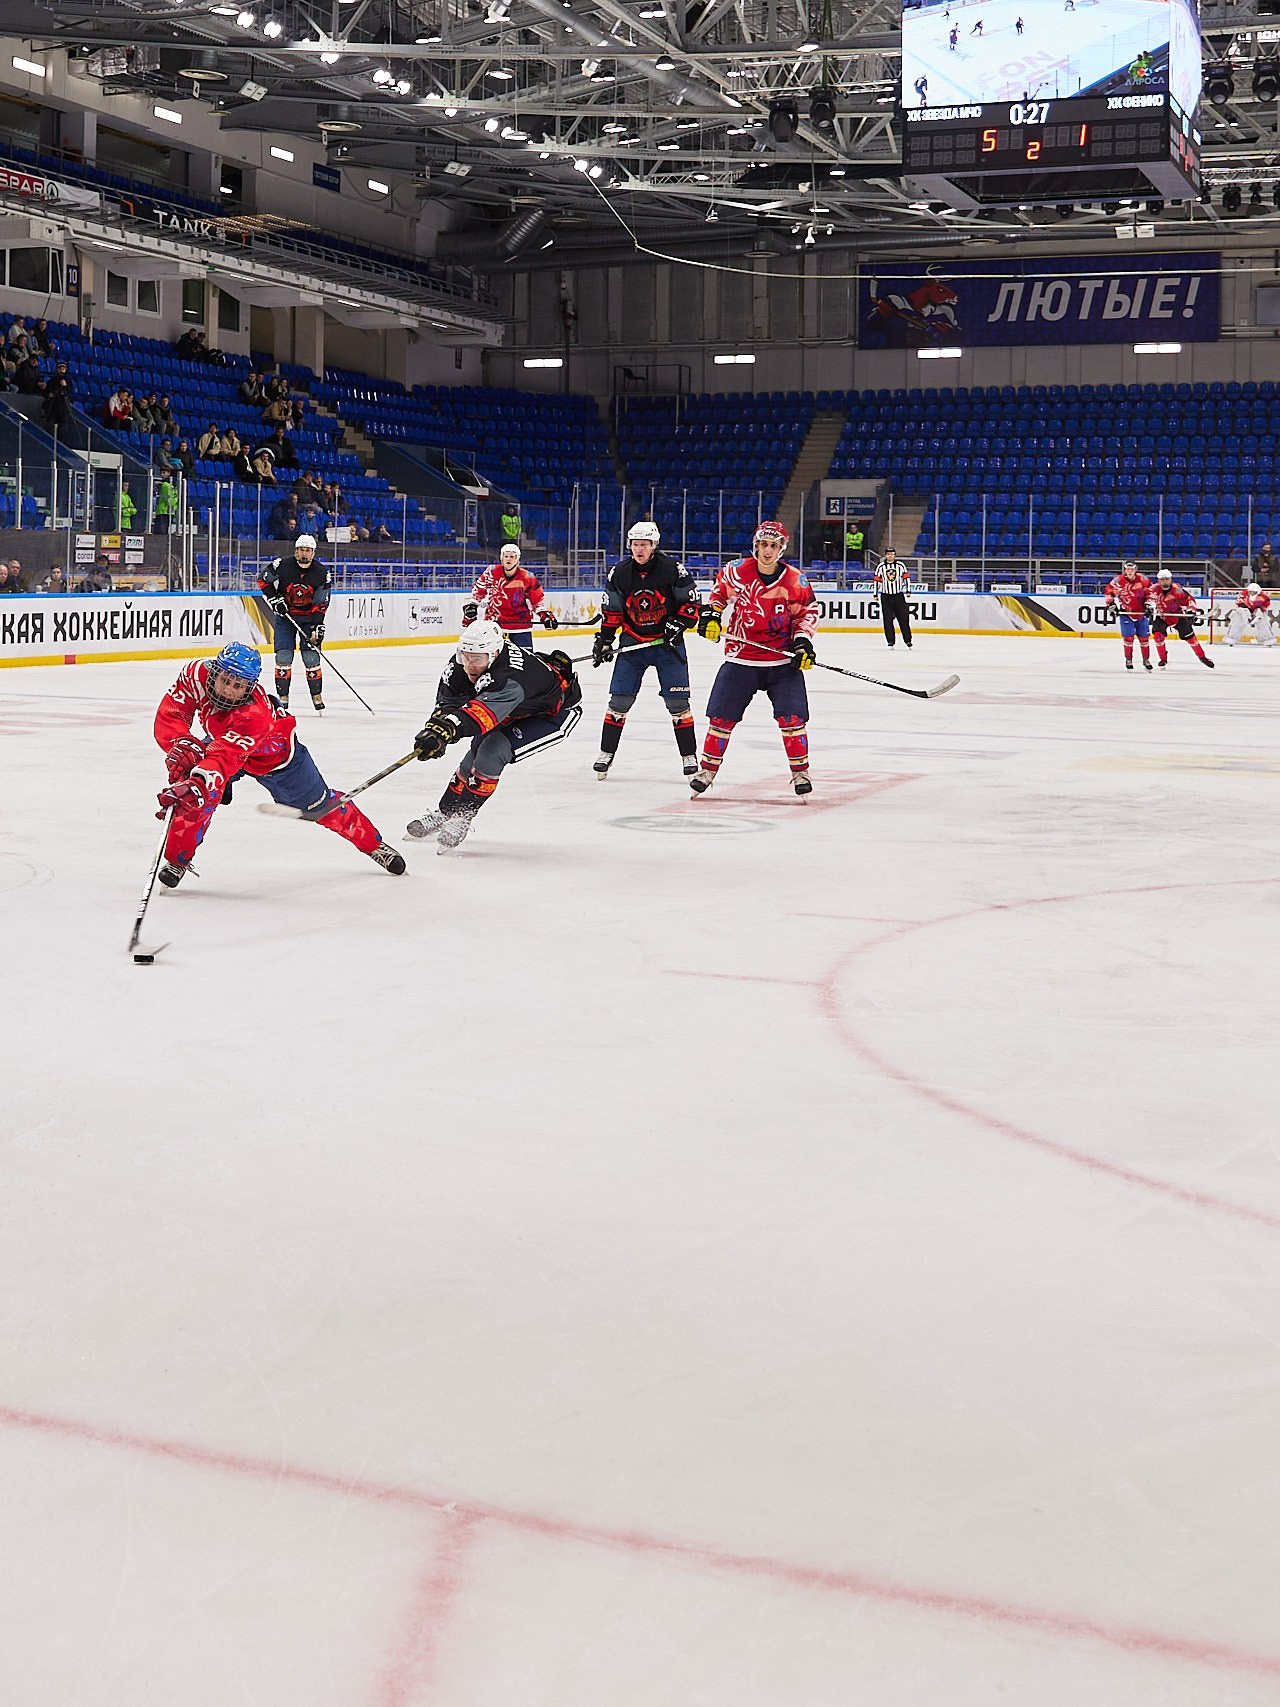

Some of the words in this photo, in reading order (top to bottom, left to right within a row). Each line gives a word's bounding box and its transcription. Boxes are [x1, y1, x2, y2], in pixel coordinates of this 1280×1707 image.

[1009, 103, 1050, 125] 0:27
[981, 129, 997, 152] 5
[1079, 124, 1087, 146] 1
[1026, 141, 1041, 160] 2
[69, 268, 78, 284] 10
[987, 277, 1201, 323] ЛЮТЫЕ!
[346, 597, 385, 620] ЛИГА
[420, 603, 439, 614] НИЖНИЙ
[53, 601, 172, 642] ХОККЕЙНАЯ
[179, 608, 224, 637] ЛИГА
[420, 615, 443, 625] НОВГОРОД
[348, 624, 384, 637] СИЛЬНЫХ
[425, 722, 451, 741] CCM
